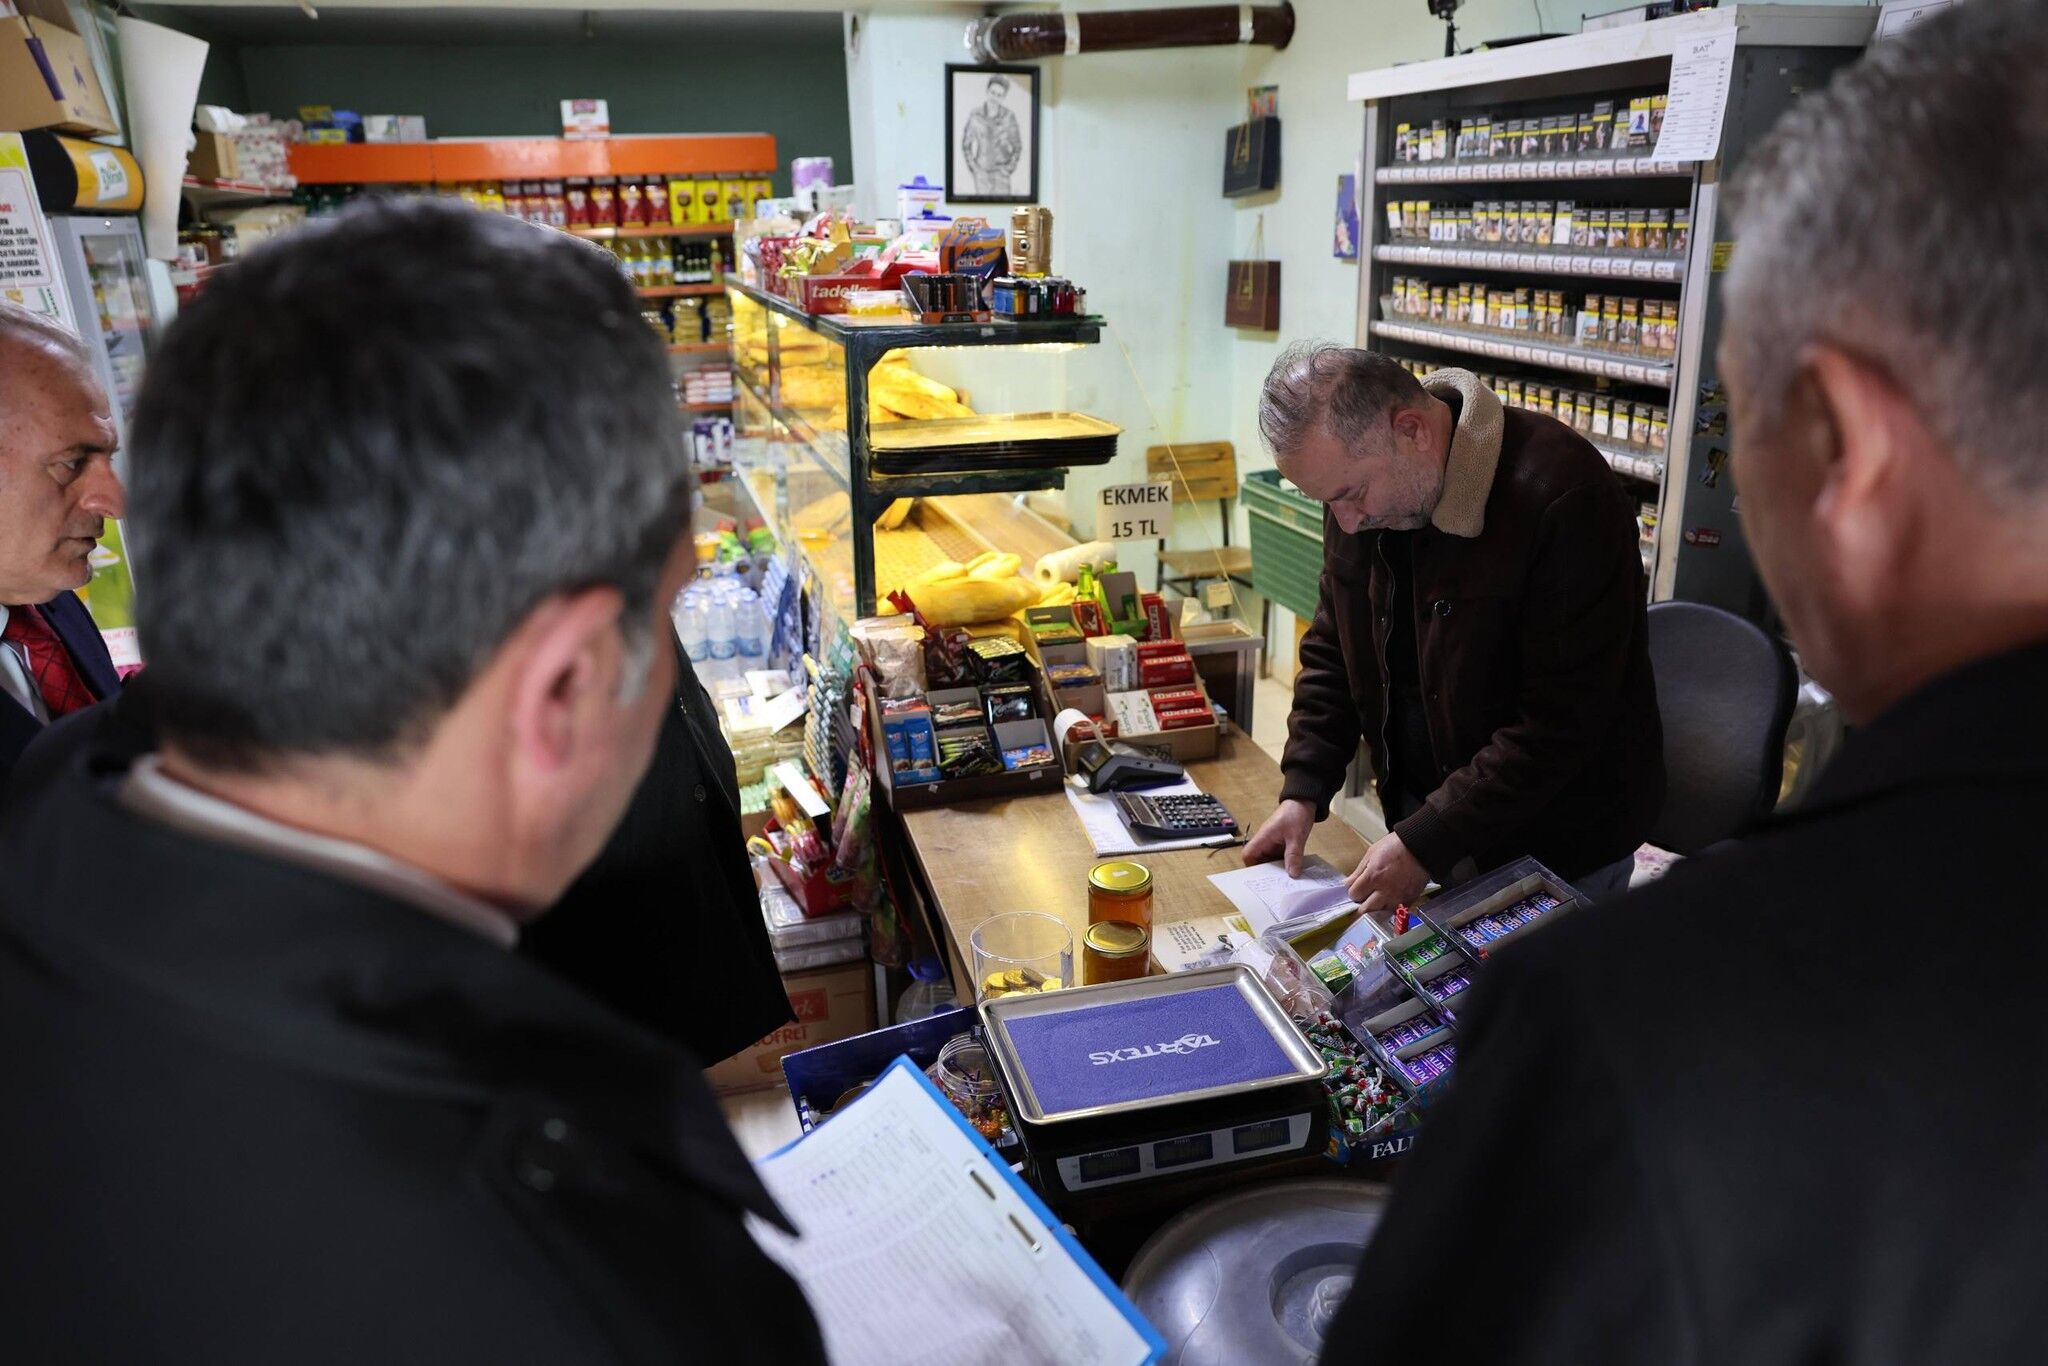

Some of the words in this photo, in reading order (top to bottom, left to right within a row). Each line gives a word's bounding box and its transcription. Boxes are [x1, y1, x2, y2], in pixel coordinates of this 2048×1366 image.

[1104, 486, 1168, 505] EKMEK
[1112, 521, 1132, 538] 15
[1139, 520, 1158, 535] TL
[757, 1025, 811, 1047] OFRET
[1088, 1033, 1221, 1066] TARTEXS
[1406, 1061, 1431, 1082] FALIM
